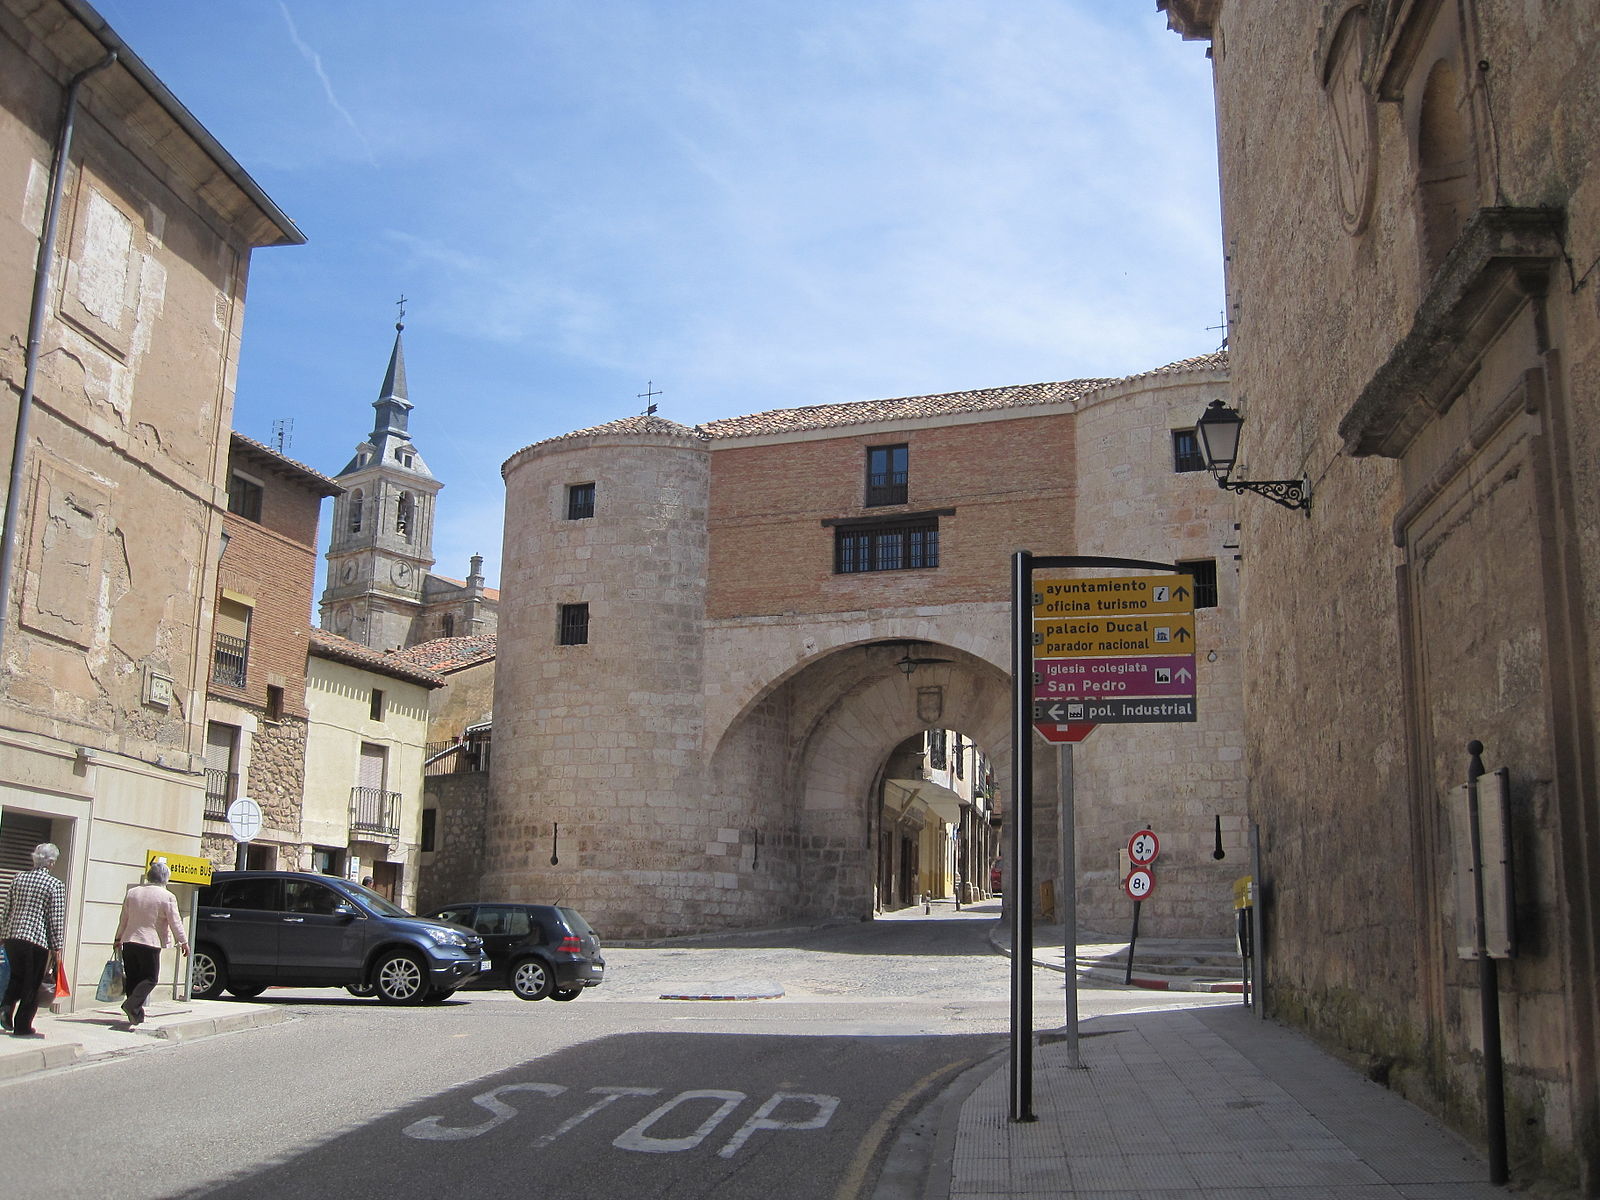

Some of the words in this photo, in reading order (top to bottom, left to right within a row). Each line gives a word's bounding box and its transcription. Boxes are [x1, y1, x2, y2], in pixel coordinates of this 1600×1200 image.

[1046, 580, 1147, 595] ayuntamiento
[1046, 600, 1091, 612] oficina
[1097, 599, 1148, 610] turismo
[1046, 622, 1099, 637] palacio
[1106, 621, 1149, 633] Ducal
[1046, 640, 1093, 654] parador
[1098, 639, 1150, 650] nacional
[1047, 664, 1086, 676] iglesia
[1091, 662, 1148, 674] colegiata
[1047, 680, 1076, 692] San
[1082, 679, 1127, 691] Pedro
[1089, 705, 1116, 719] pol.
[1122, 703, 1192, 716] industrial
[199, 865, 212, 877] BUS
[401, 1082, 842, 1159] STOP
